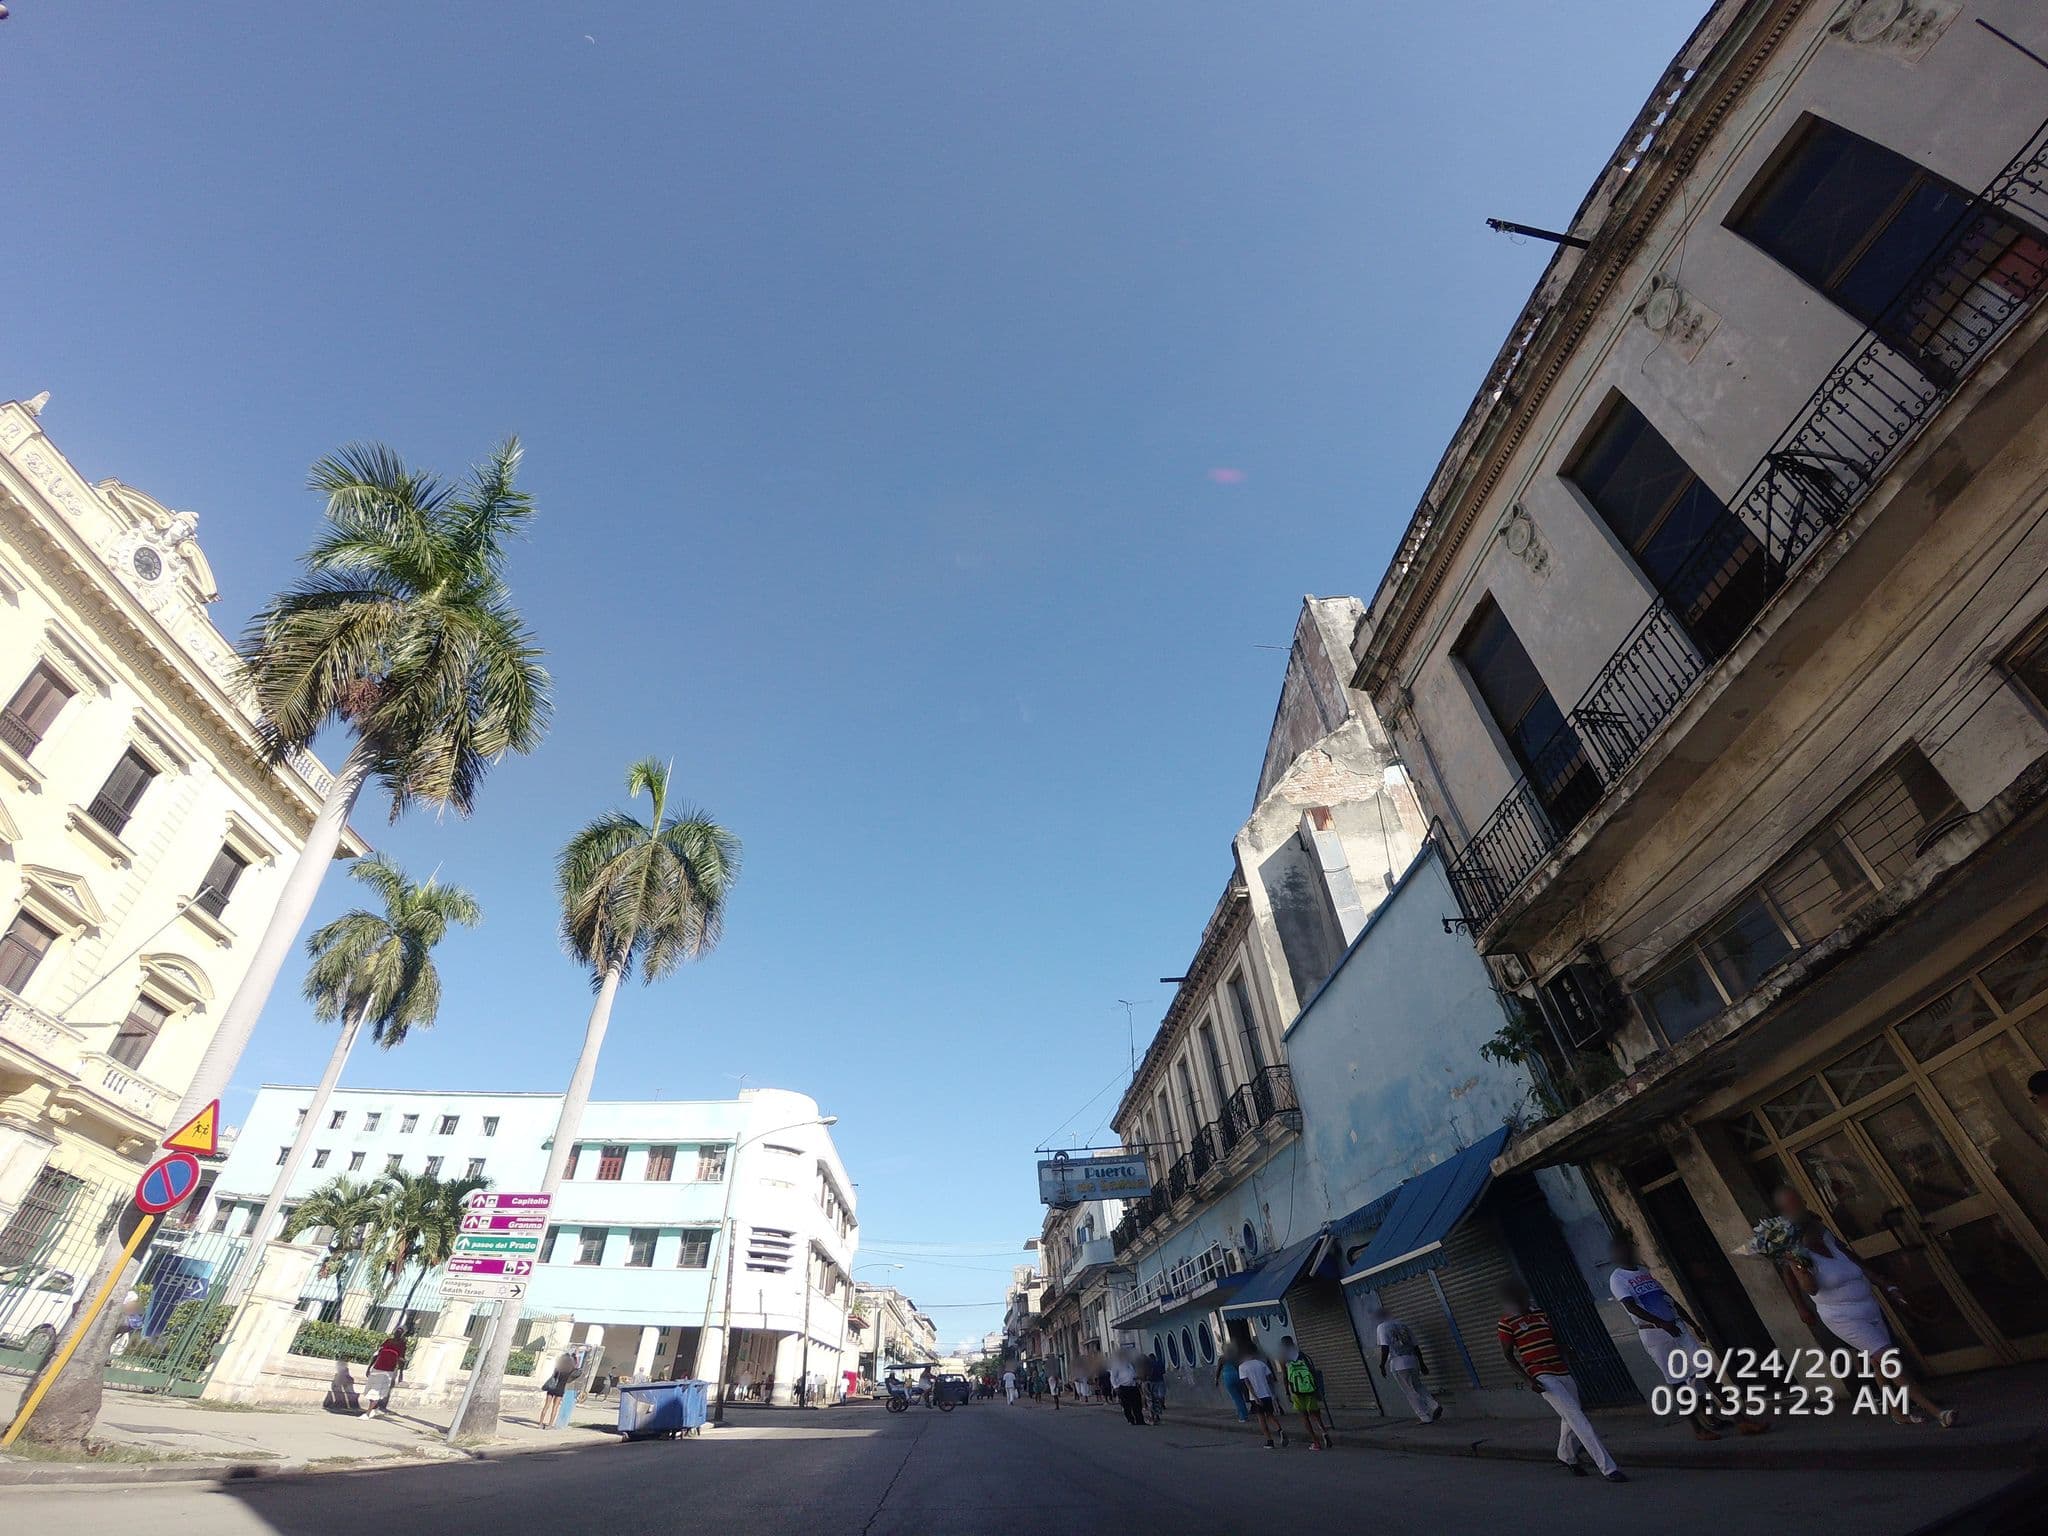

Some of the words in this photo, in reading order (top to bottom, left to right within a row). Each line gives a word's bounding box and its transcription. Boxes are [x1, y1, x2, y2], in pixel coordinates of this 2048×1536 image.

[1084, 1166, 1136, 1179] Puerto
[511, 1197, 549, 1206] Capitolio
[508, 1221, 543, 1229] Granma
[495, 1241, 508, 1249] del
[509, 1241, 536, 1249] Prado
[449, 1263, 474, 1272] Belén
[464, 1288, 486, 1296] Israel
